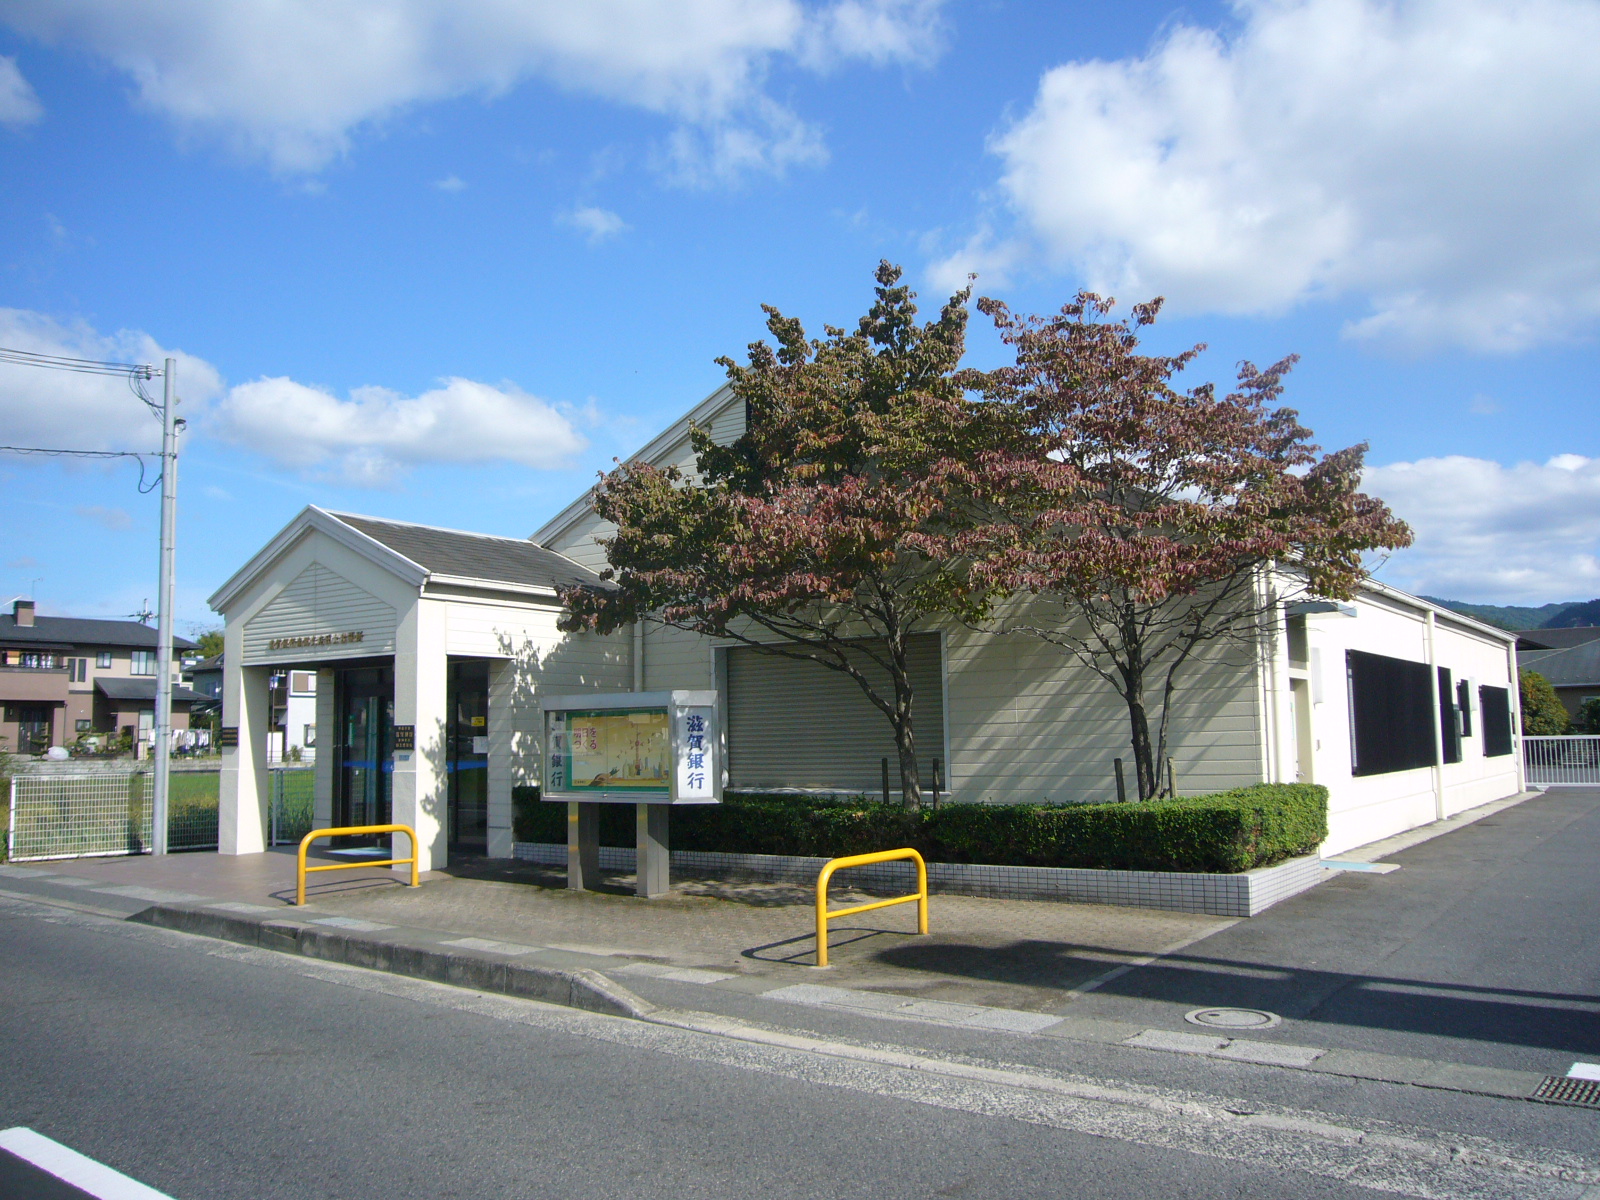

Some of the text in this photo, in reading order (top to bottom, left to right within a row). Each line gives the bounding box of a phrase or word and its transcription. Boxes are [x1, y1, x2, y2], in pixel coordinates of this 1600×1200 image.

[551, 717, 563, 787] 賀銀行
[573, 739, 597, 750] つくる
[686, 715, 705, 790] 滋賀銀行
